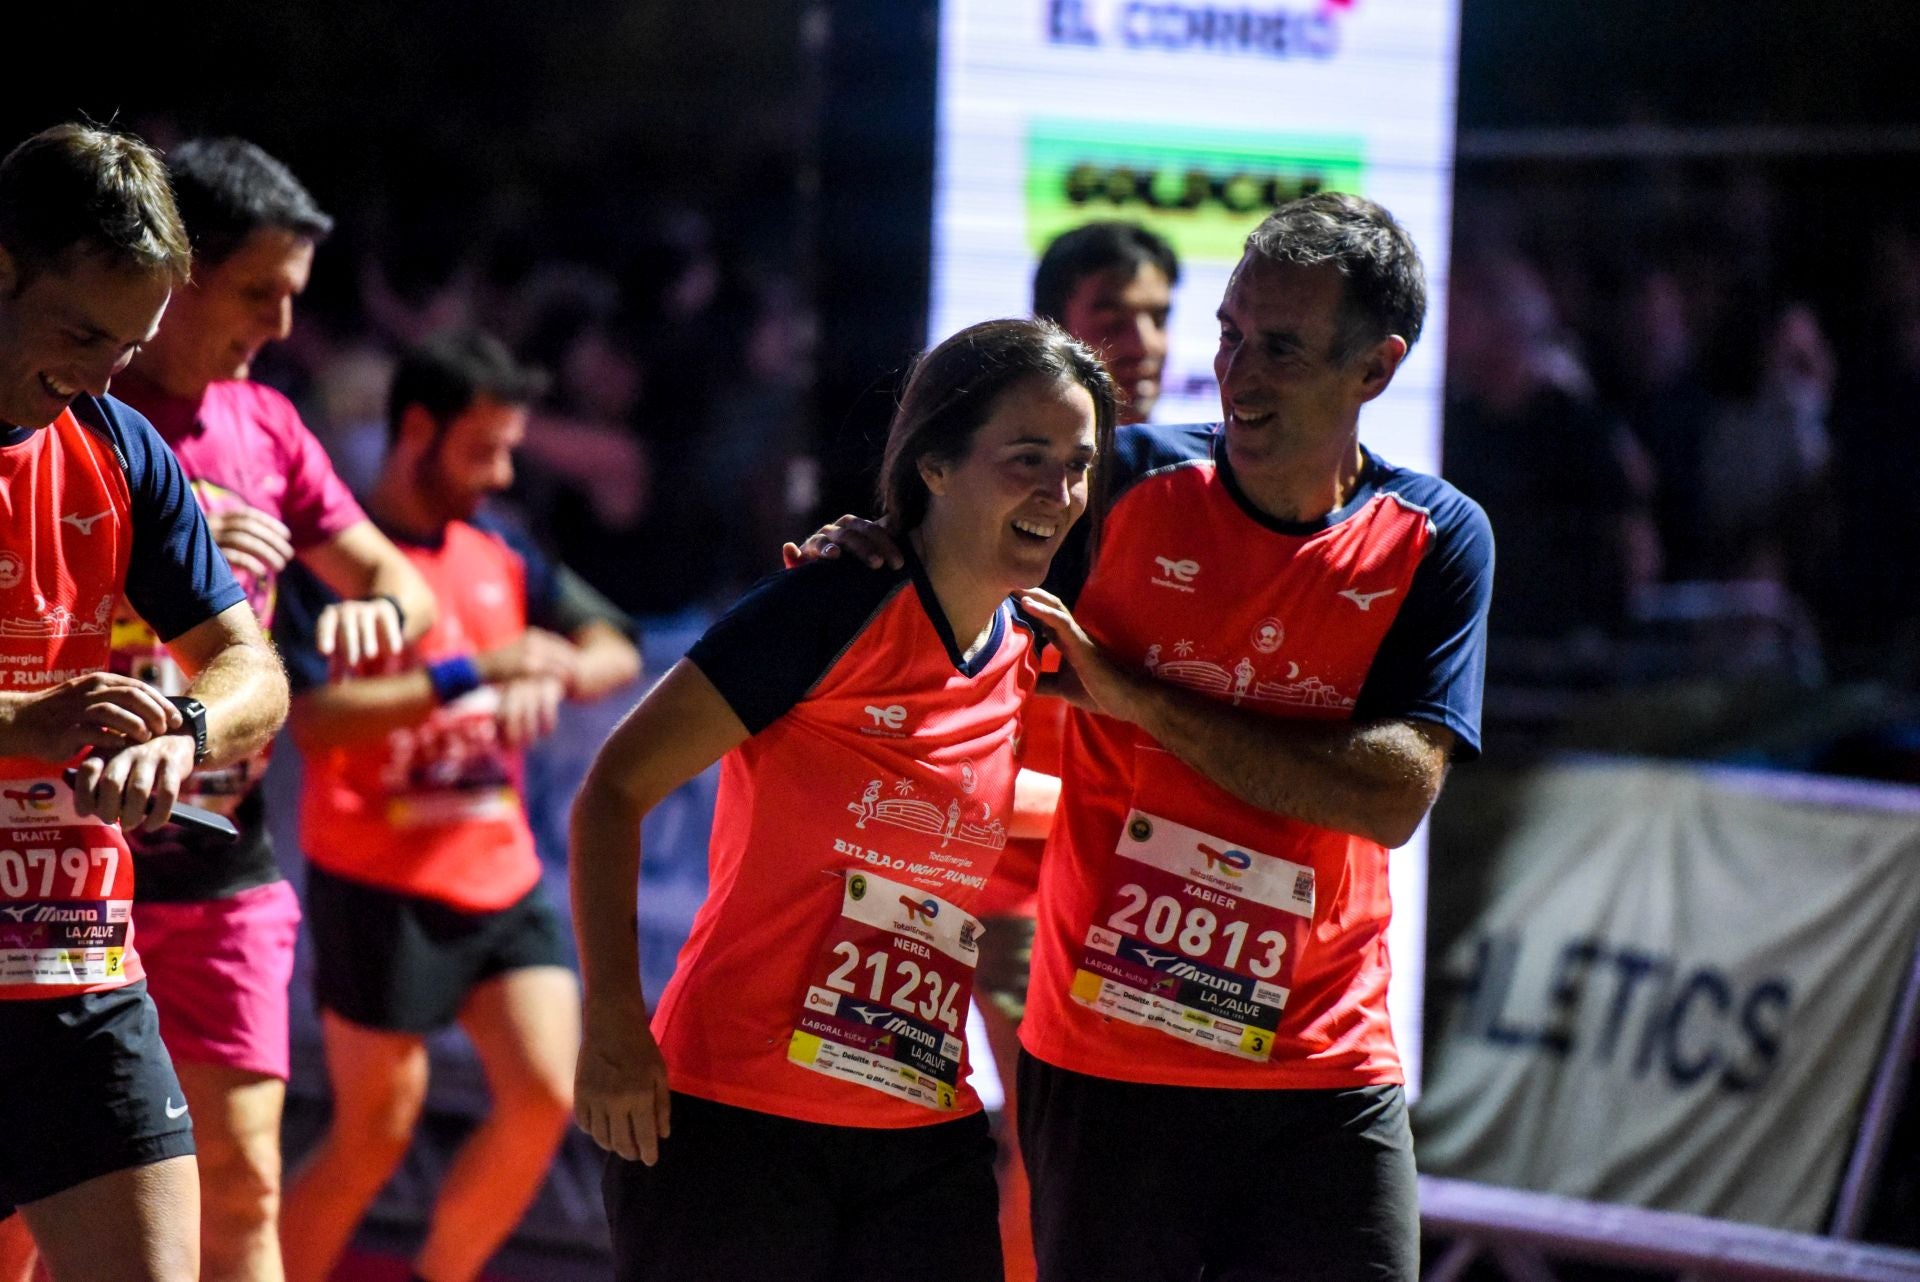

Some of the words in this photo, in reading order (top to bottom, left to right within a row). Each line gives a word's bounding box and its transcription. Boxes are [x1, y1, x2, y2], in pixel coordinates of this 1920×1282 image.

[12, 831, 62, 842] EKAITZ
[833, 838, 905, 870] BILBAO
[906, 863, 945, 878] NIGHT
[0, 848, 119, 898] 0797
[1182, 883, 1237, 910] XABIER
[66, 926, 81, 938] LA
[83, 925, 114, 938] SALVE
[1107, 883, 1287, 979] 20813
[893, 937, 931, 960] NEREA
[111, 957, 118, 971] 3
[1085, 957, 1123, 977] LABORAL
[825, 941, 961, 1032] 21234
[1200, 990, 1219, 1006] LA
[1220, 996, 1261, 1017] SALVE
[801, 1017, 842, 1037] LABORAL
[1251, 1037, 1264, 1052] 3
[911, 1044, 922, 1060] LA
[921, 1052, 946, 1072] SALVE
[943, 1093, 952, 1108] 3
